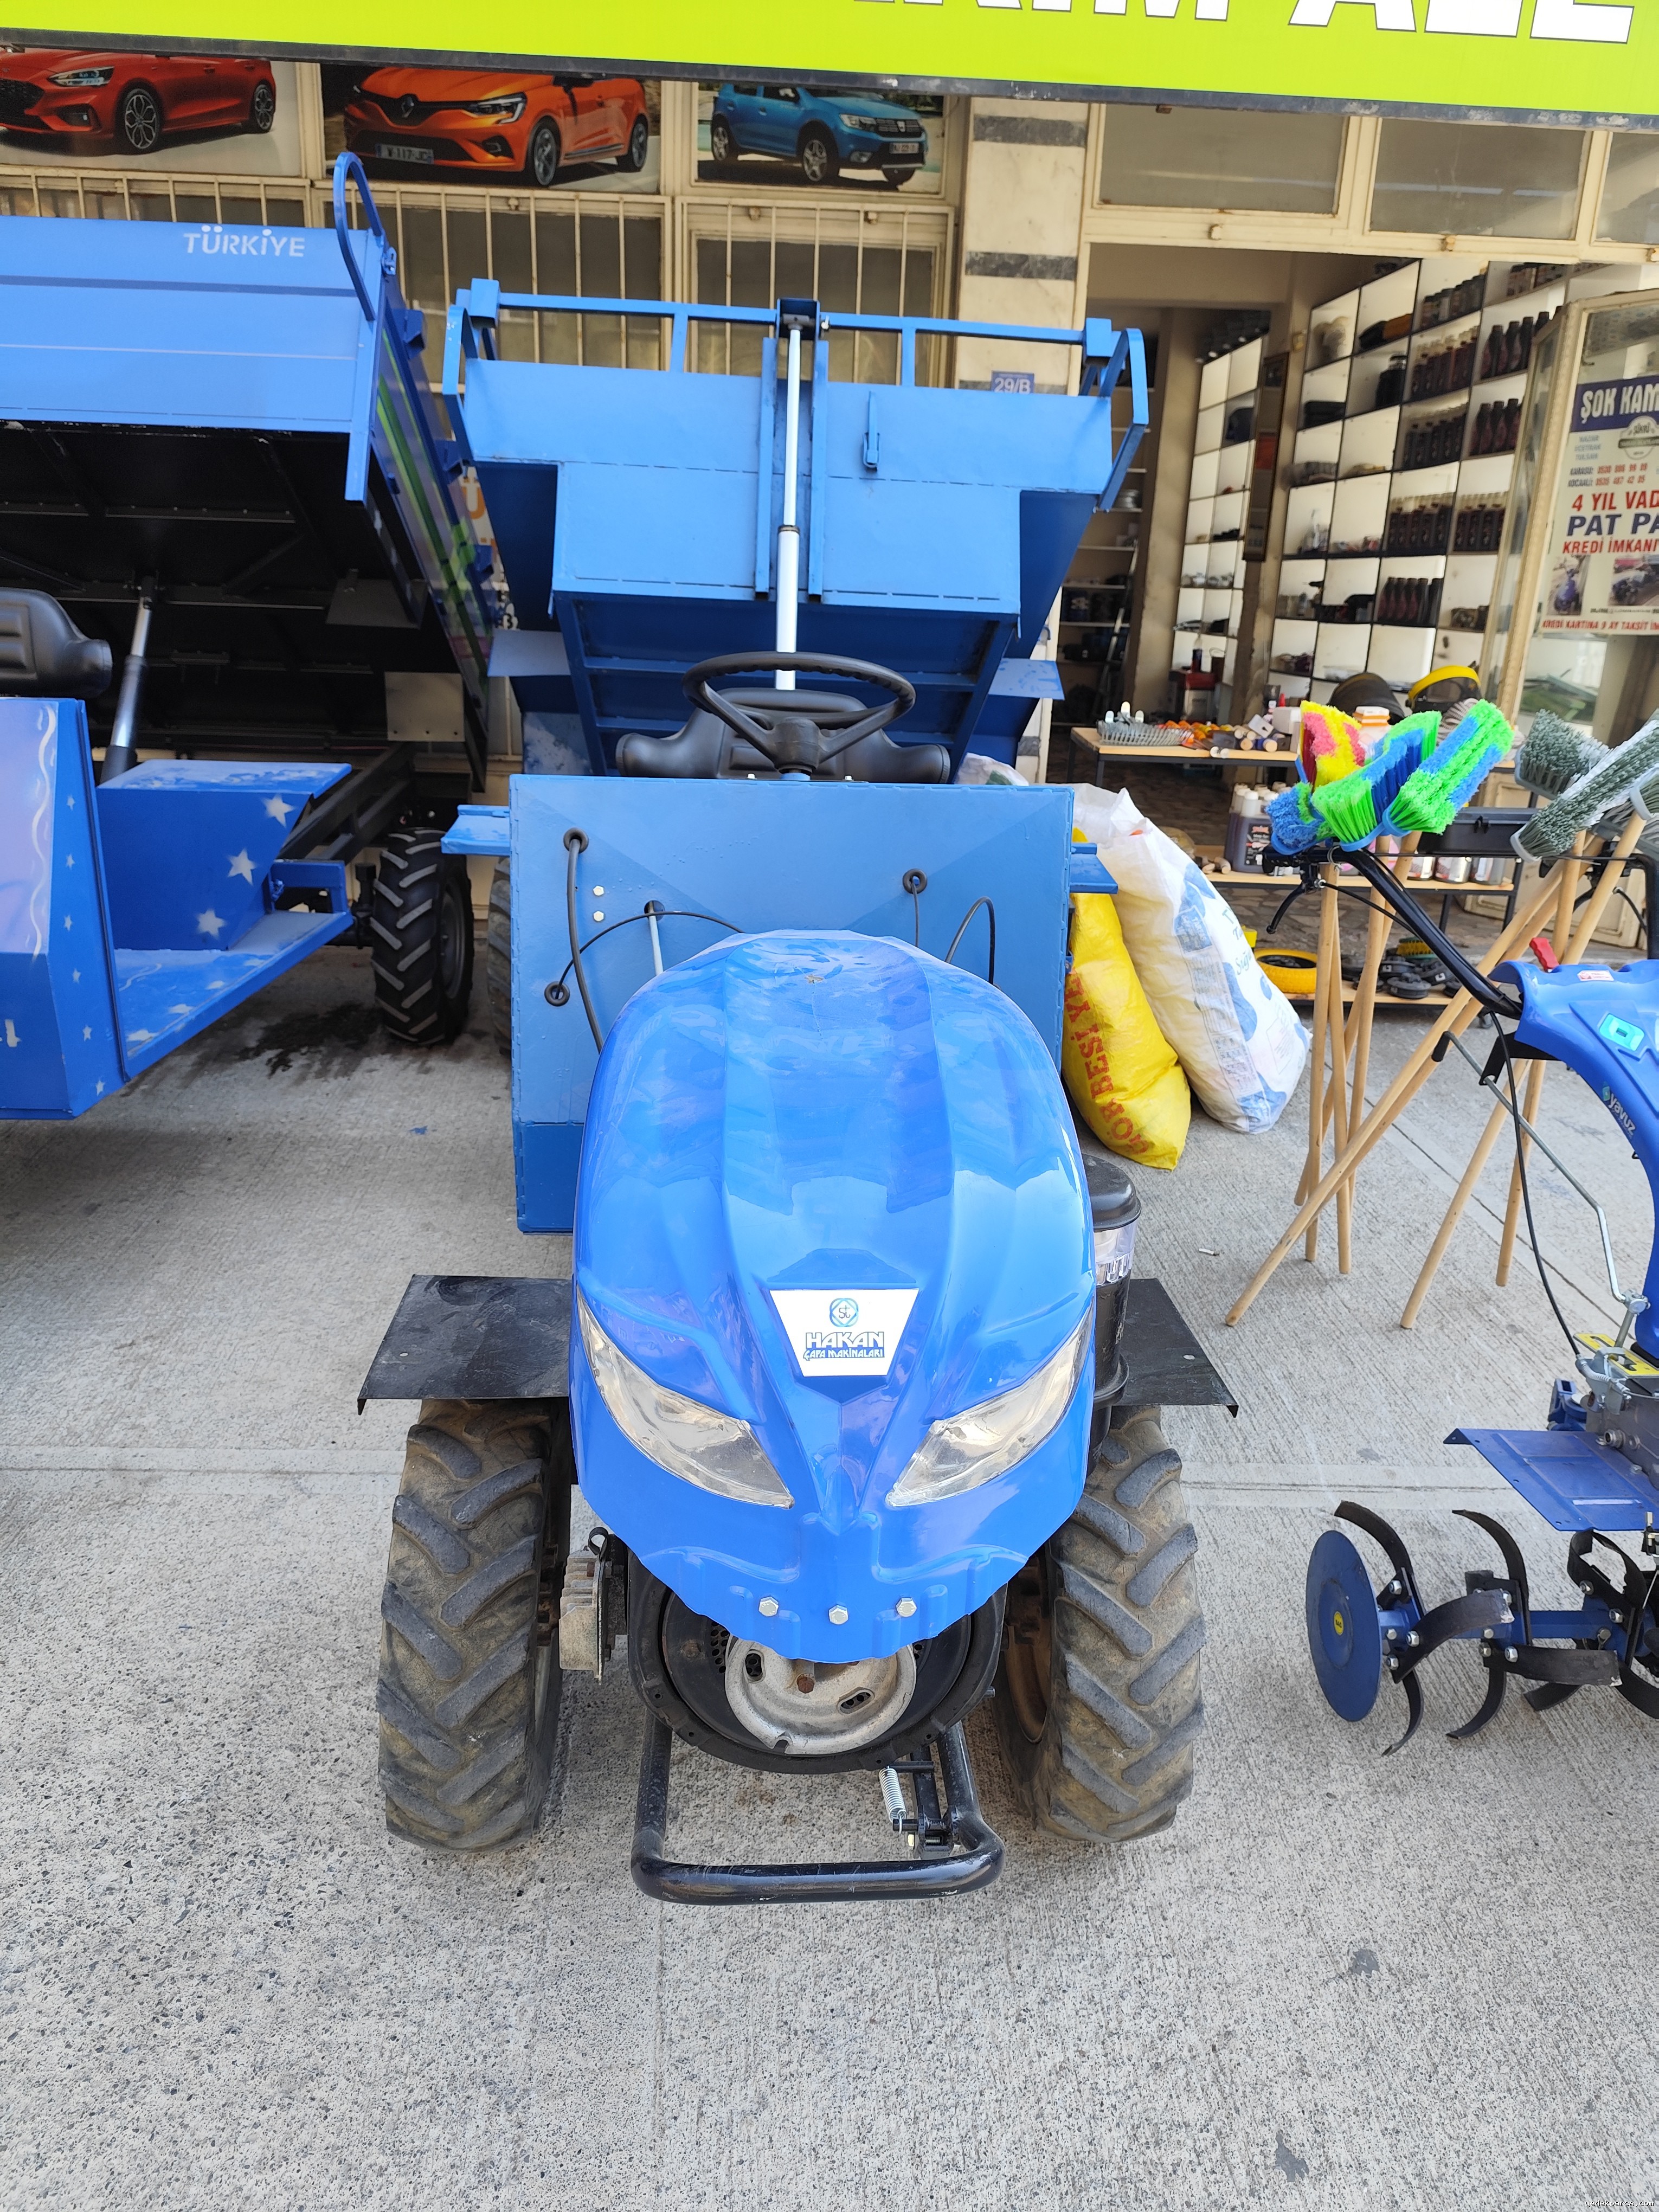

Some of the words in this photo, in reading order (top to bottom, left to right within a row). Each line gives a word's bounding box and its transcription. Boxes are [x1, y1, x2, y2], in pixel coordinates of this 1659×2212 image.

[183, 225, 305, 257] TÜRKİYE
[994, 377, 1031, 395] 29/B
[1580, 388, 1617, 424] ŞOK
[1572, 494, 1583, 511] 4
[1592, 492, 1617, 511] YIL
[1567, 514, 1622, 536] PAT
[1562, 536, 1604, 554] KREDİ
[1608, 536, 1659, 553] İMKANI
[1064, 969, 1091, 1023] YE
[1070, 1023, 1114, 1099] BESİ
[1608, 1093, 1636, 1135] yavuz
[805, 1332, 885, 1349] HAKAN
[803, 1349, 826, 1361] ÇAPA
[827, 1348, 884, 1359] MAKİNALARI
